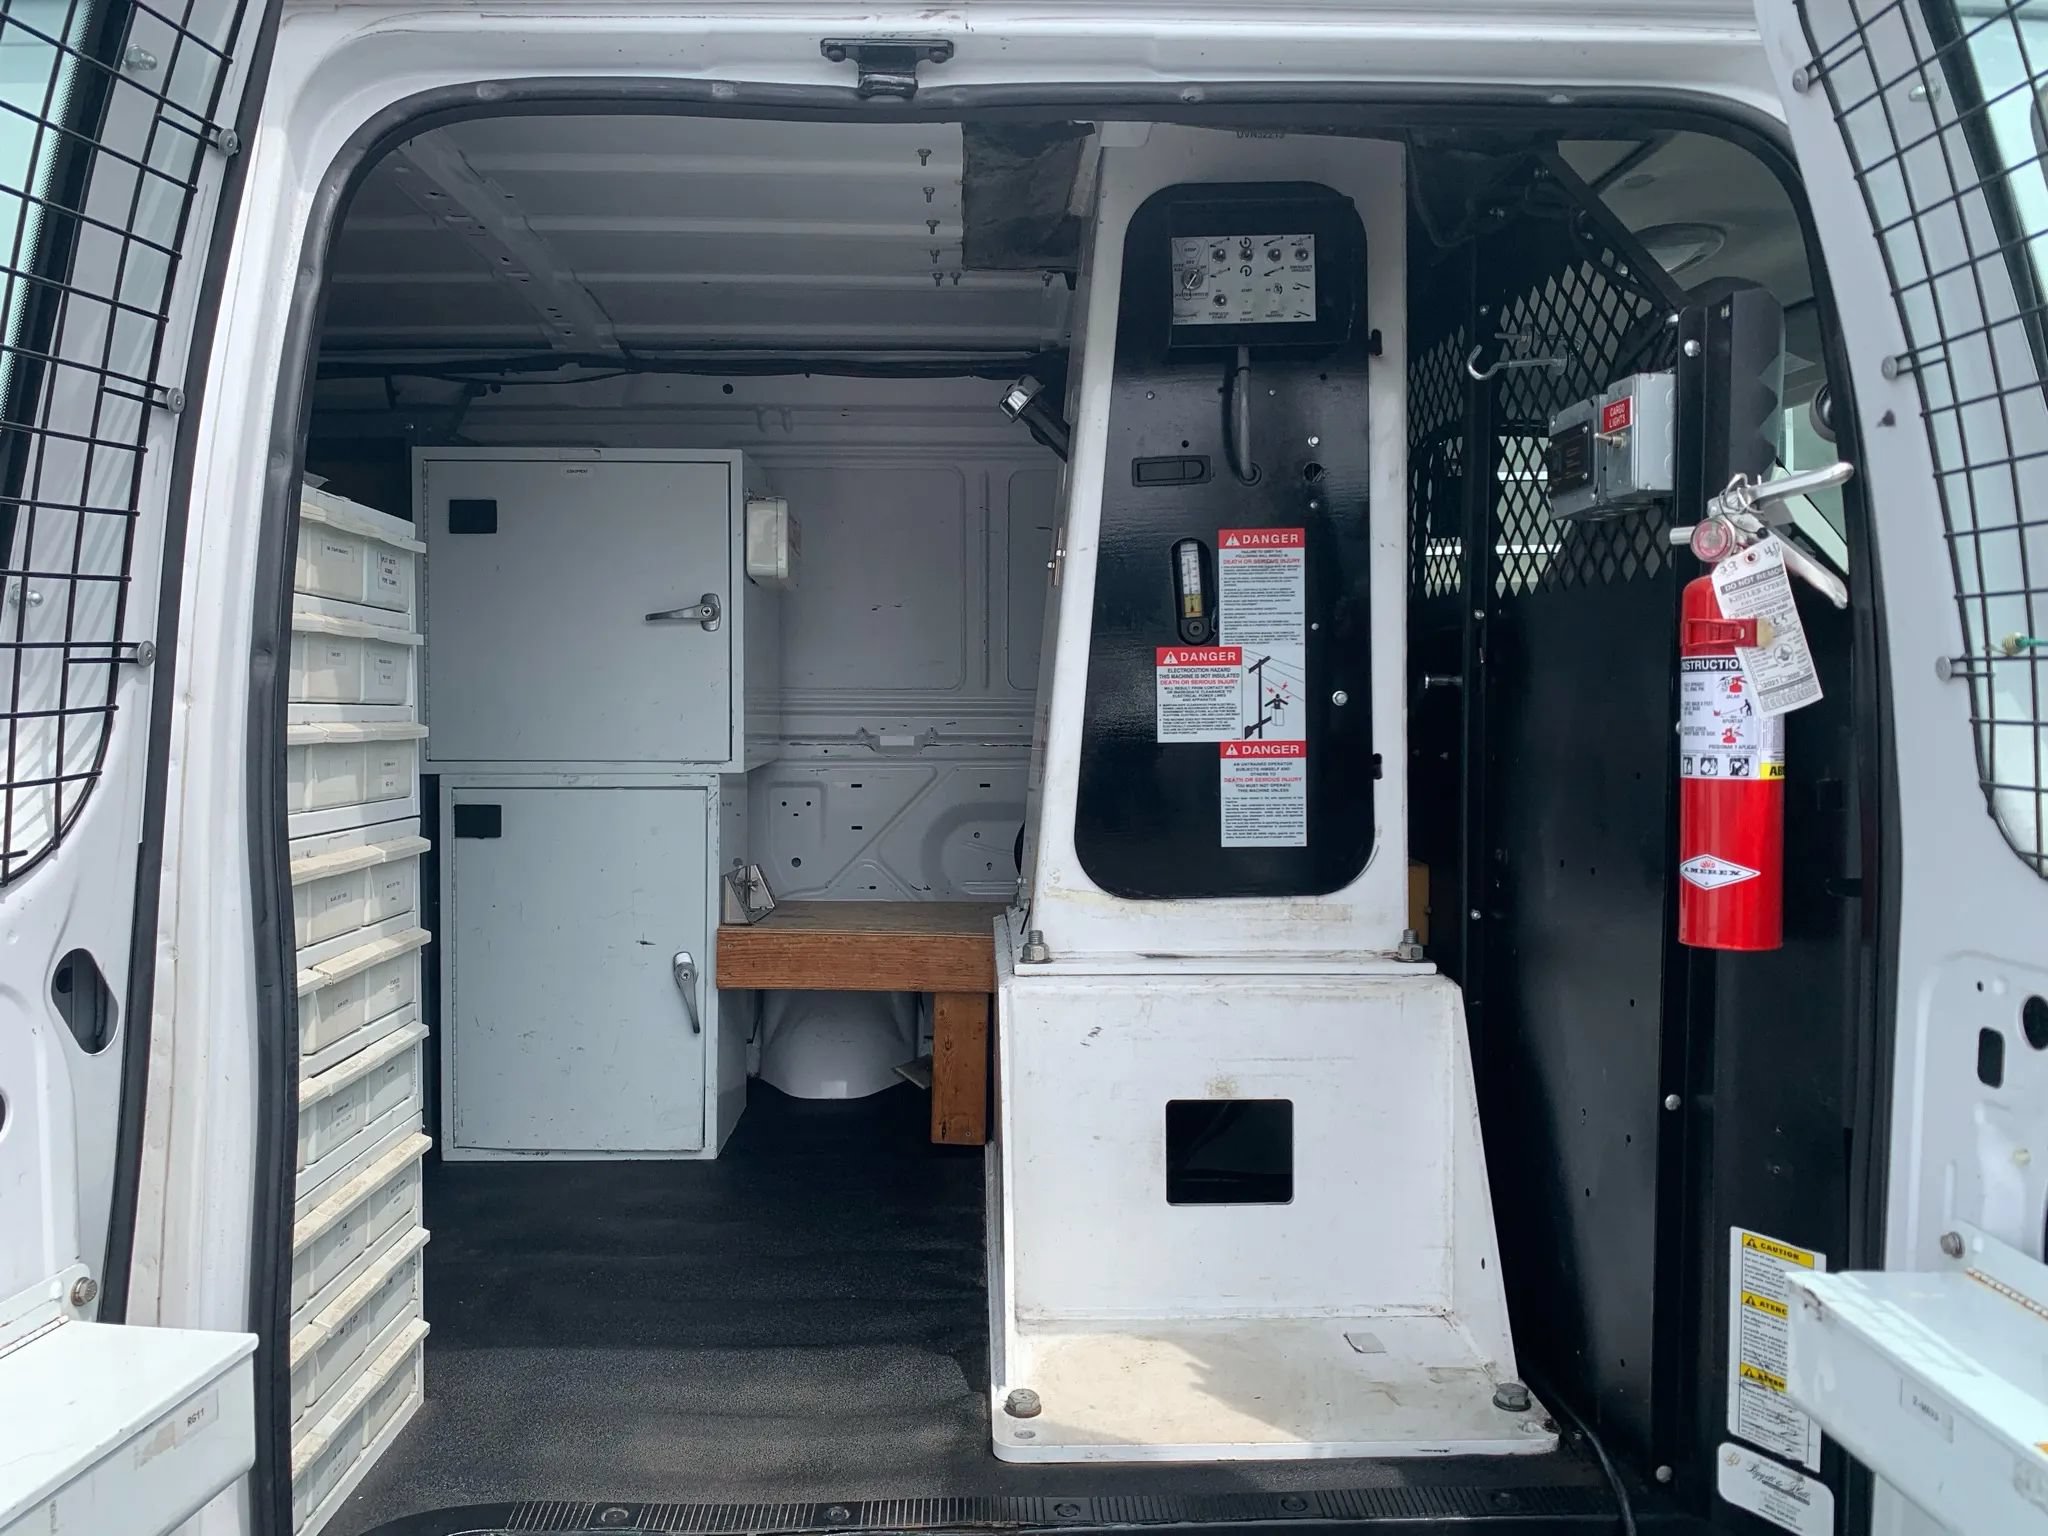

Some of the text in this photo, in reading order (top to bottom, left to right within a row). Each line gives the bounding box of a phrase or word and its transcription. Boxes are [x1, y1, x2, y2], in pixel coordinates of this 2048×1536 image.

[1609, 403, 1626, 417] CARGO
[1609, 414, 1626, 428] LIGHTS
[1242, 533, 1299, 544] DANGER
[1738, 577, 1755, 587] NOT
[1180, 651, 1236, 662] DANGER
[1242, 744, 1300, 755] DANGER
[1684, 866, 1742, 876] AMEREX
[1760, 1242, 1800, 1260] CAUTION
[1759, 1301, 1788, 1315] ATENC
[187, 1407, 204, 1427] RG11
